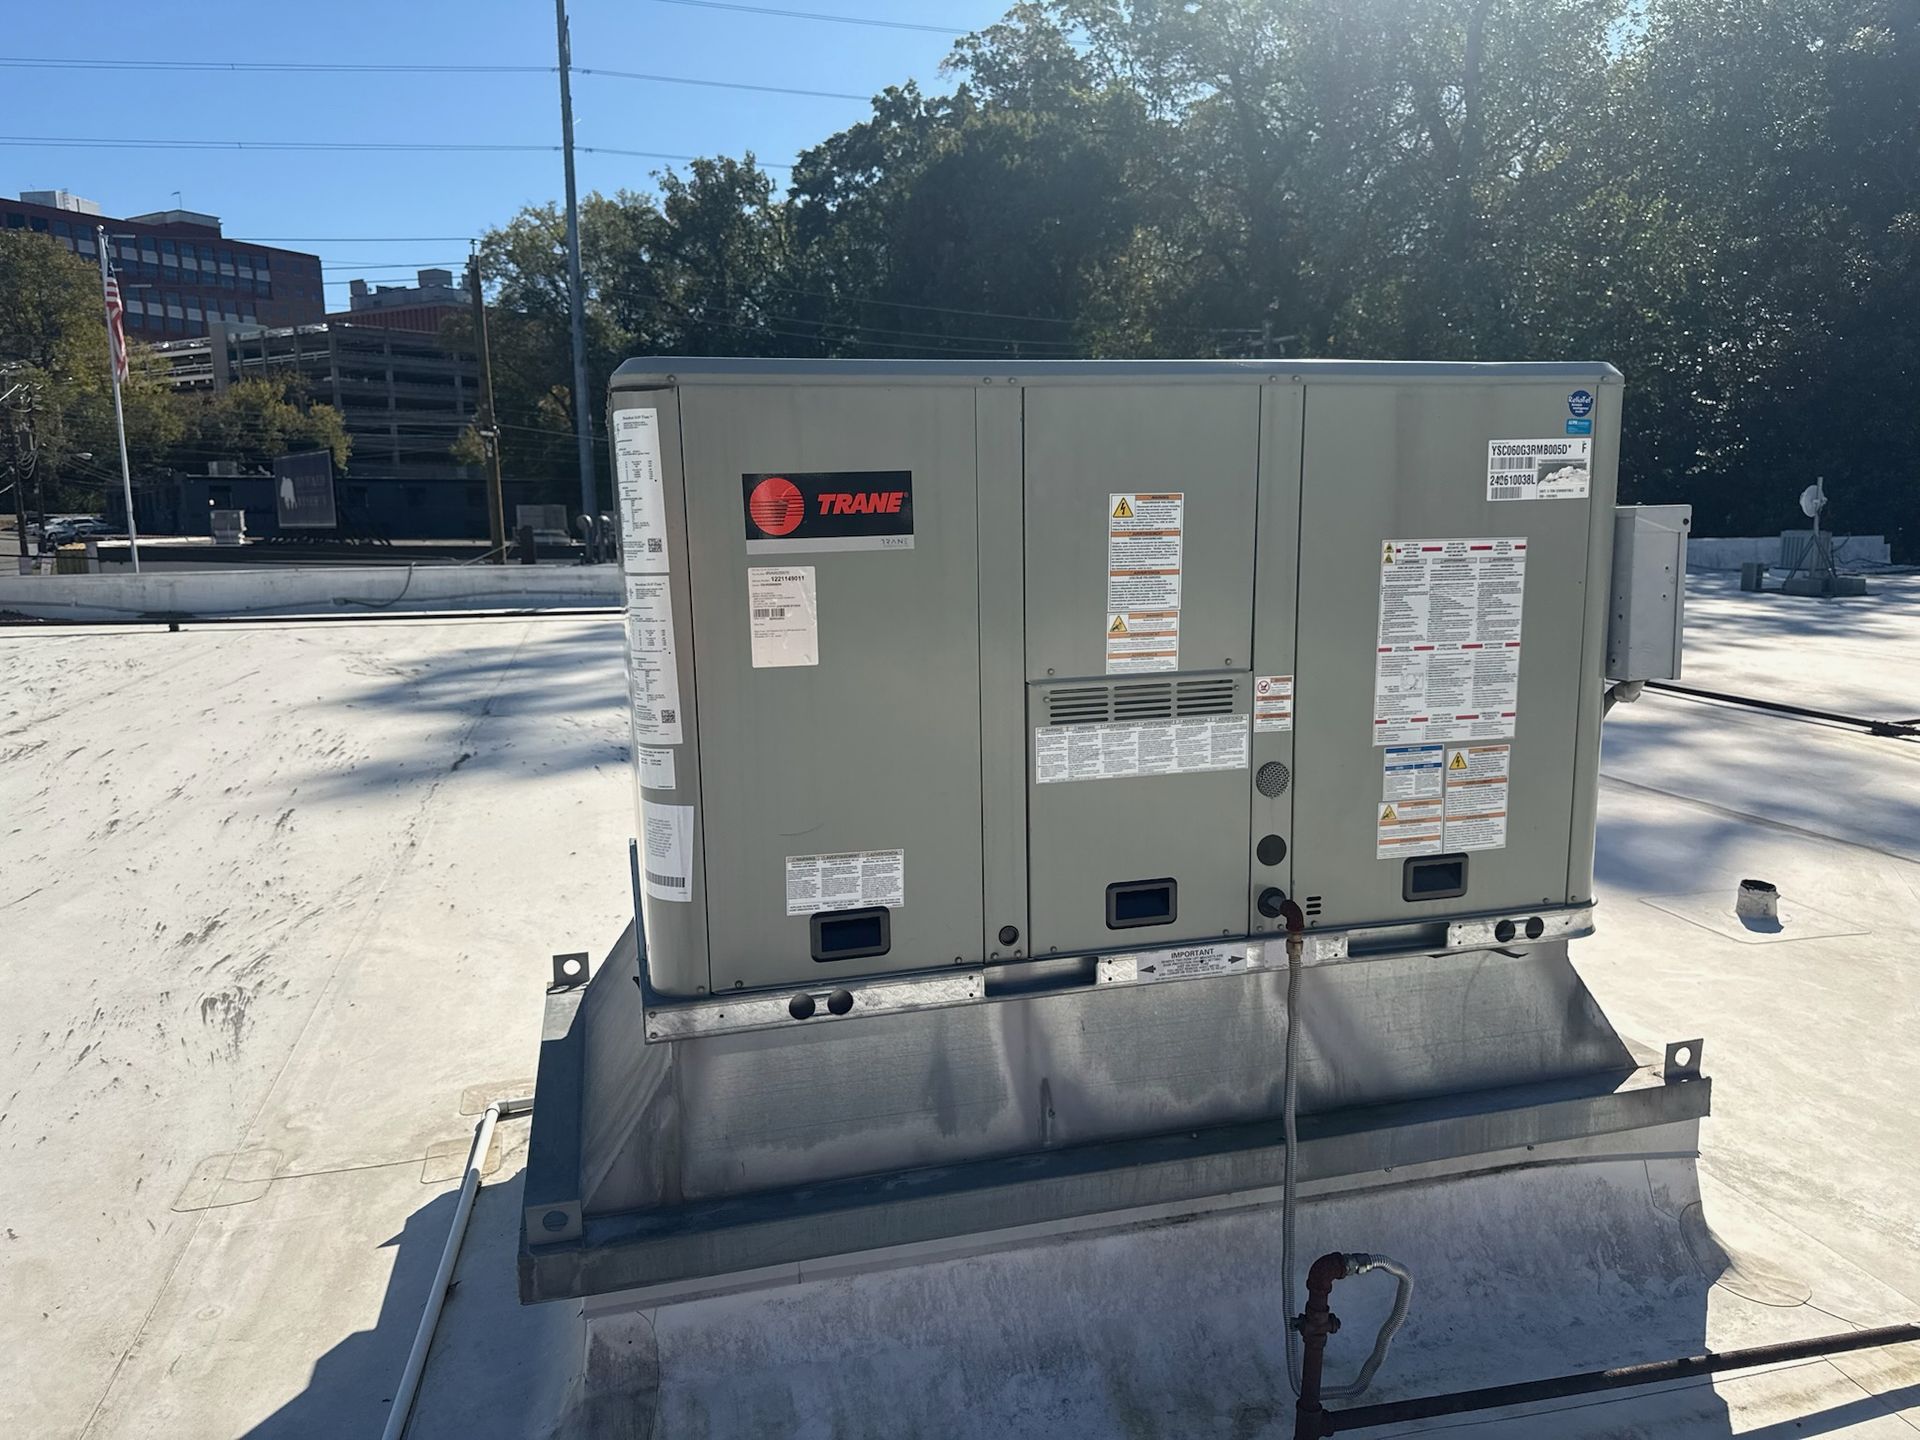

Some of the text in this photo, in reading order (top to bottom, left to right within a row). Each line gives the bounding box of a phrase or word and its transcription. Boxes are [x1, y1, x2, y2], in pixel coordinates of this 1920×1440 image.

[1581, 443, 1587, 454] F
[817, 491, 904, 515] TRANE
[1171, 948, 1214, 959] IMPORTANT
